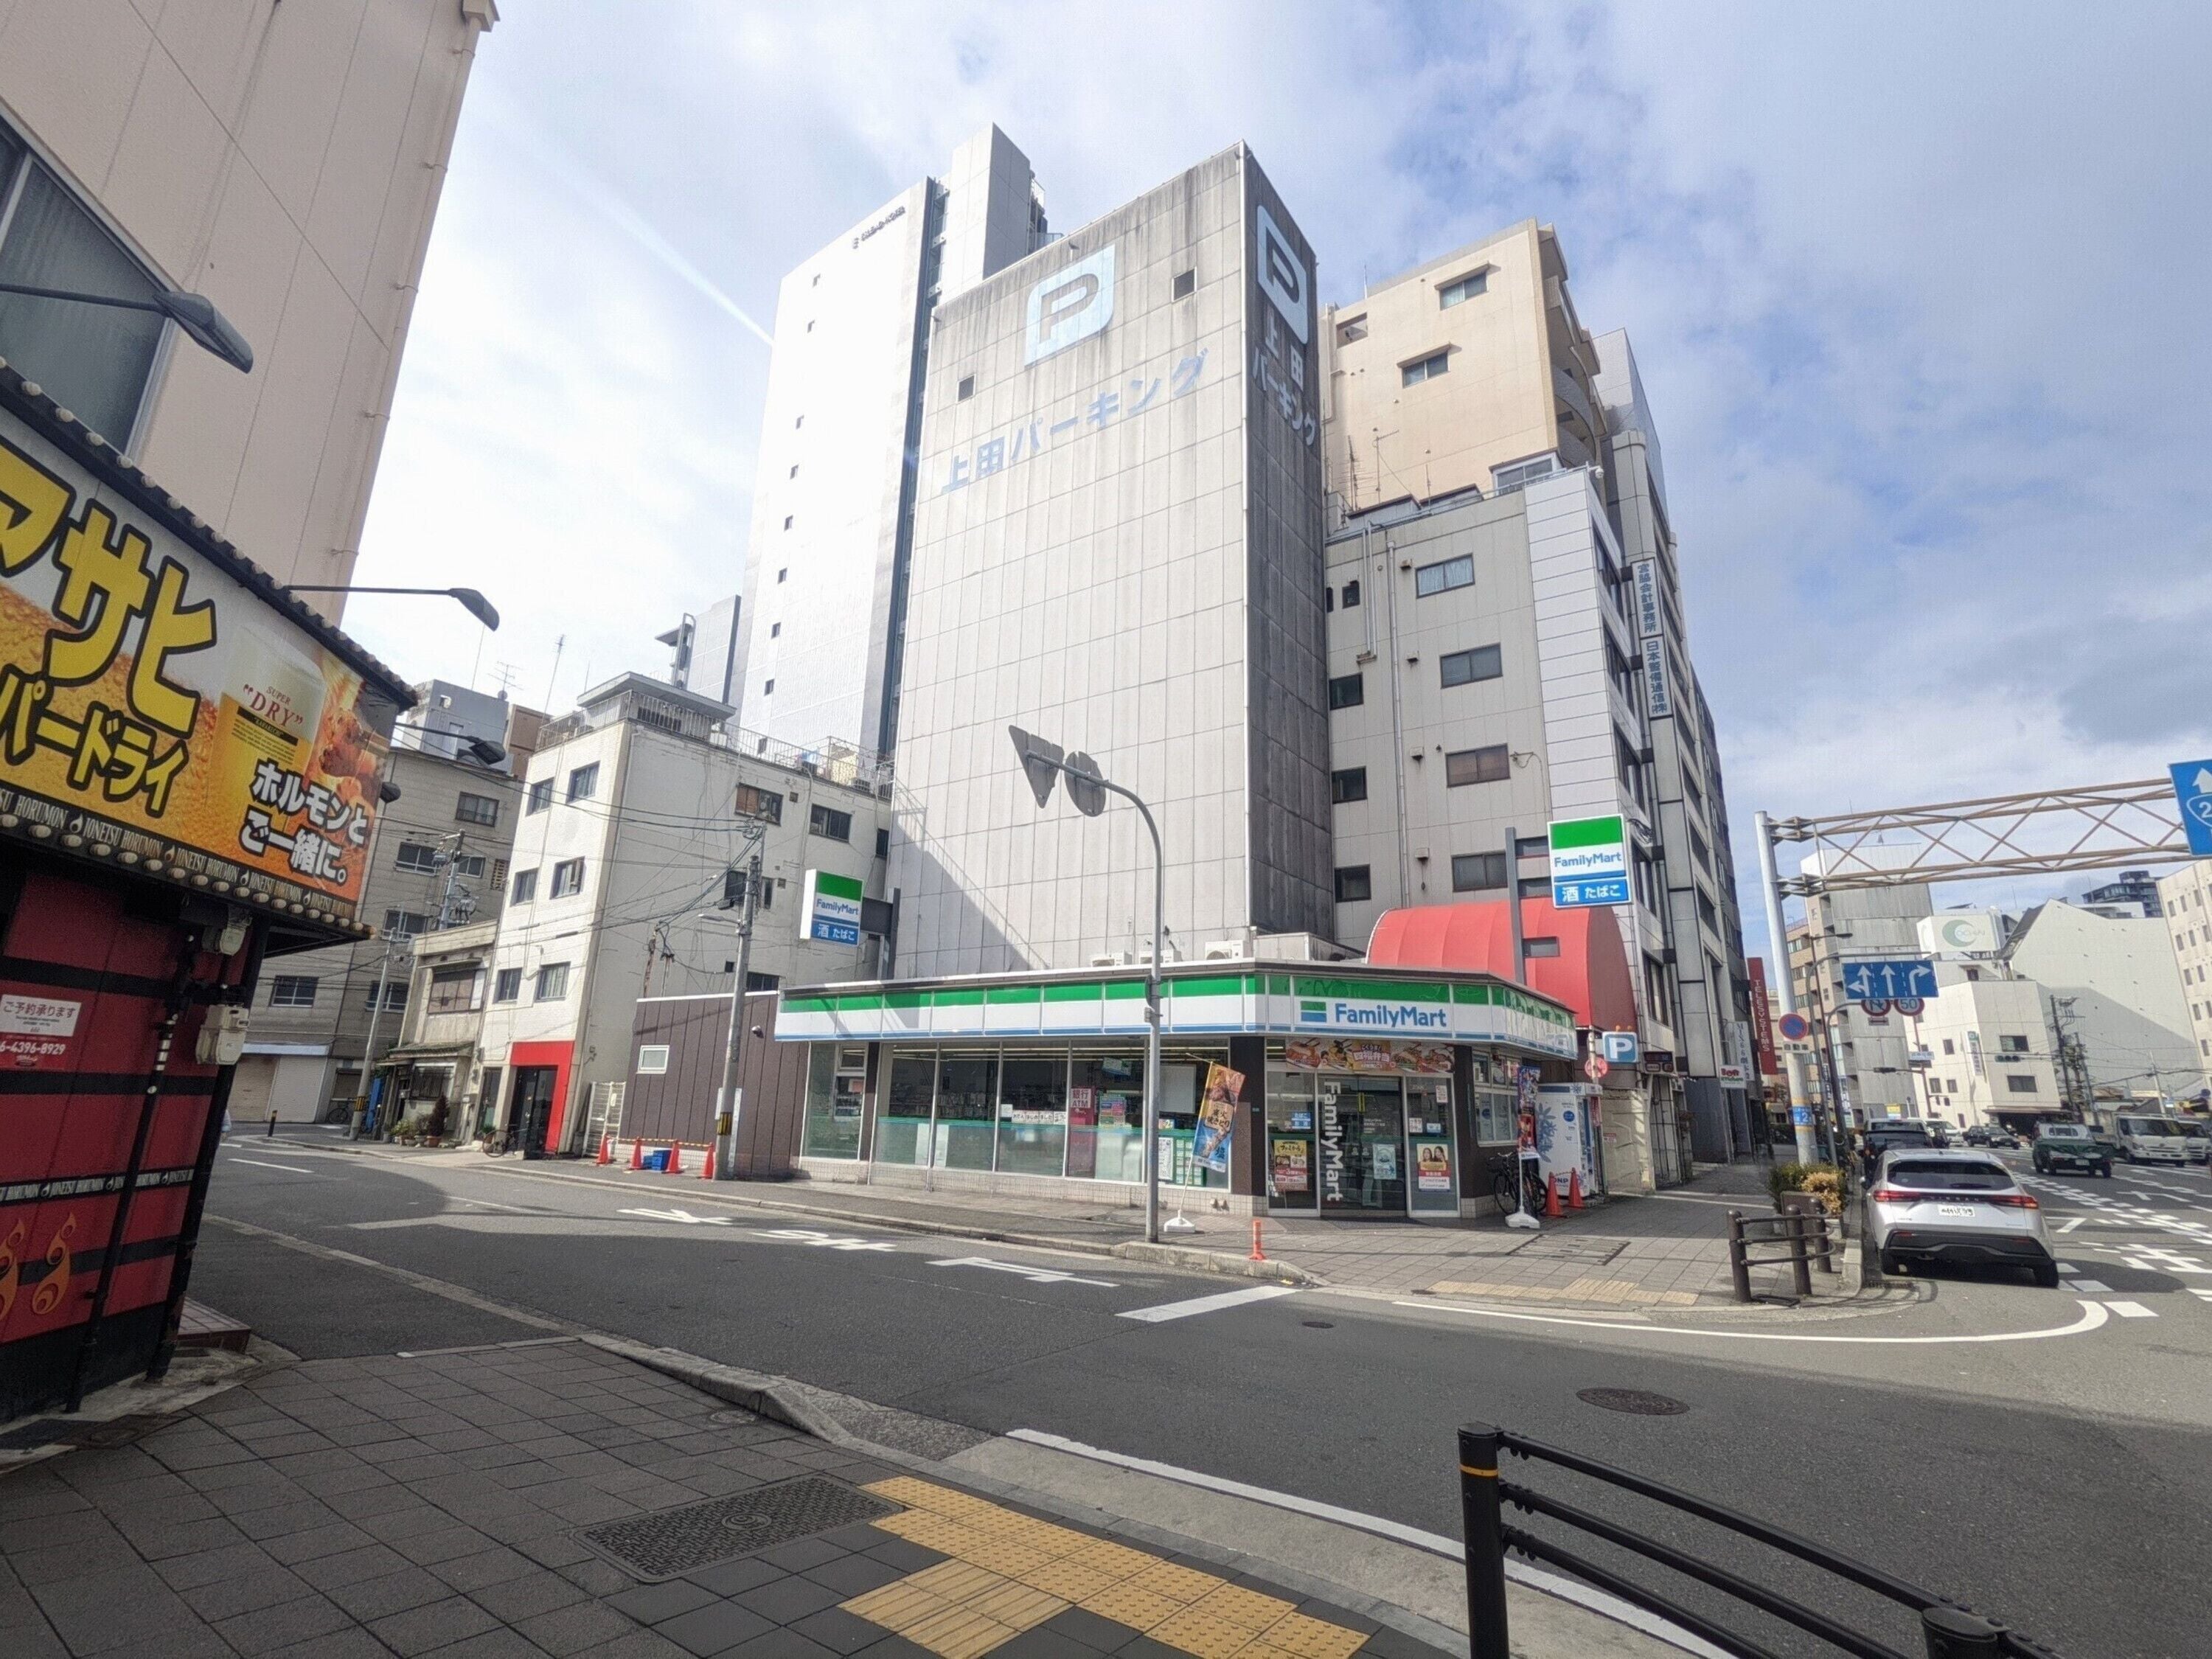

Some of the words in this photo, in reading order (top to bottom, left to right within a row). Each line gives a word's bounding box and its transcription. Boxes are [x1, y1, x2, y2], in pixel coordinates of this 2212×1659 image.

[1266, 227, 1299, 304] P
[1039, 273, 1099, 345] P
[1253, 347, 1316, 446] パーキング
[941, 347, 1209, 495] 上田パーキング
[266, 686, 291, 706] SUPER
[251, 760, 368, 846] ホルモンと
[14, 794, 69, 830] HORUMON
[120, 830, 164, 857] HORUMON
[204, 858, 240, 882] HORUMON
[240, 809, 348, 885] ご一緒に。
[1554, 852, 1622, 868] FamilyMart
[1562, 886, 1579, 902] 酒
[1584, 884, 1621, 900] たばこ
[816, 898, 859, 915] FamilyMart
[818, 923, 830, 938] 酒
[832, 928, 855, 941] たばこ
[4, 1001, 76, 1018] ご予約承ります
[1335, 1003, 1447, 1028] FamilyMart
[1753, 979, 1770, 1052] TELESYSTEMS
[1900, 998, 1918, 1009] 50
[1608, 1037, 1633, 1060] P
[1072, 1099, 1089, 1107] ATM
[1073, 1089, 1088, 1099] 銀行
[1321, 1081, 1344, 1202] FamilyMart
